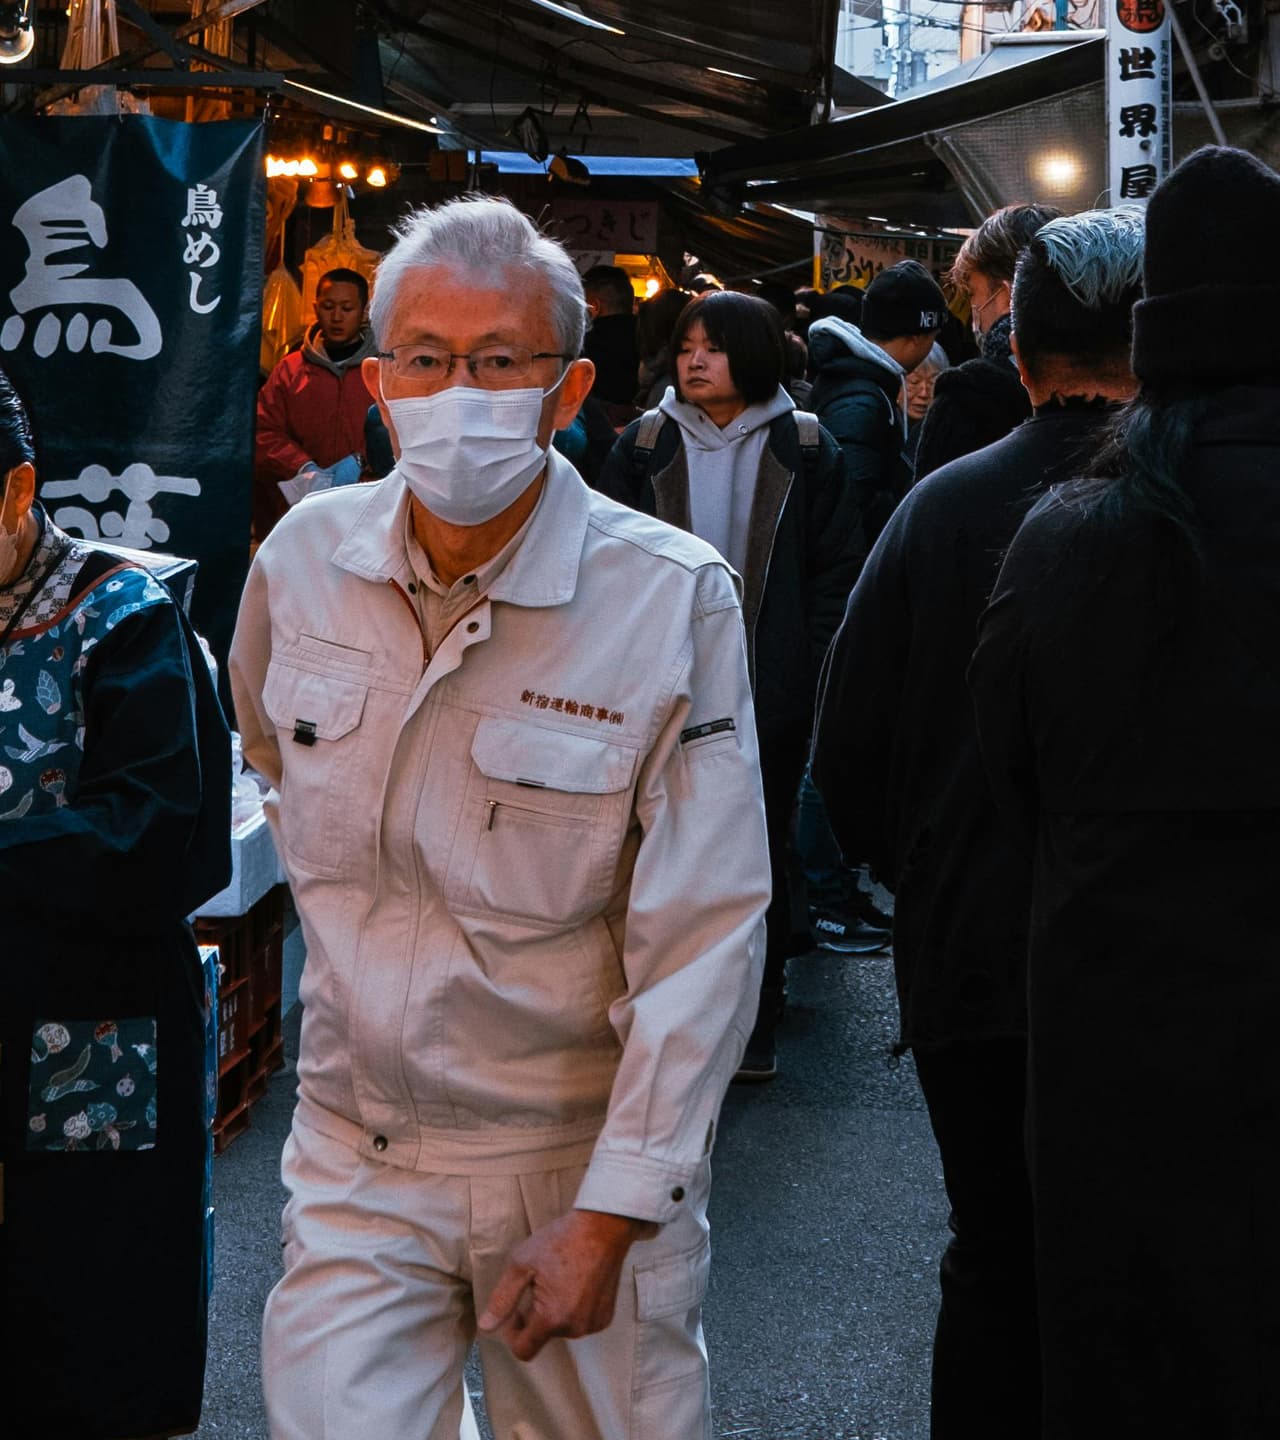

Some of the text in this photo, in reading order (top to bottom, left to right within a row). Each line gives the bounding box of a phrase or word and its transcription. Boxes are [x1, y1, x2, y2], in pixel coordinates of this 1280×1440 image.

[1118, 47, 1158, 200] 世界屋
[181, 183, 222, 315] 鳥めし
